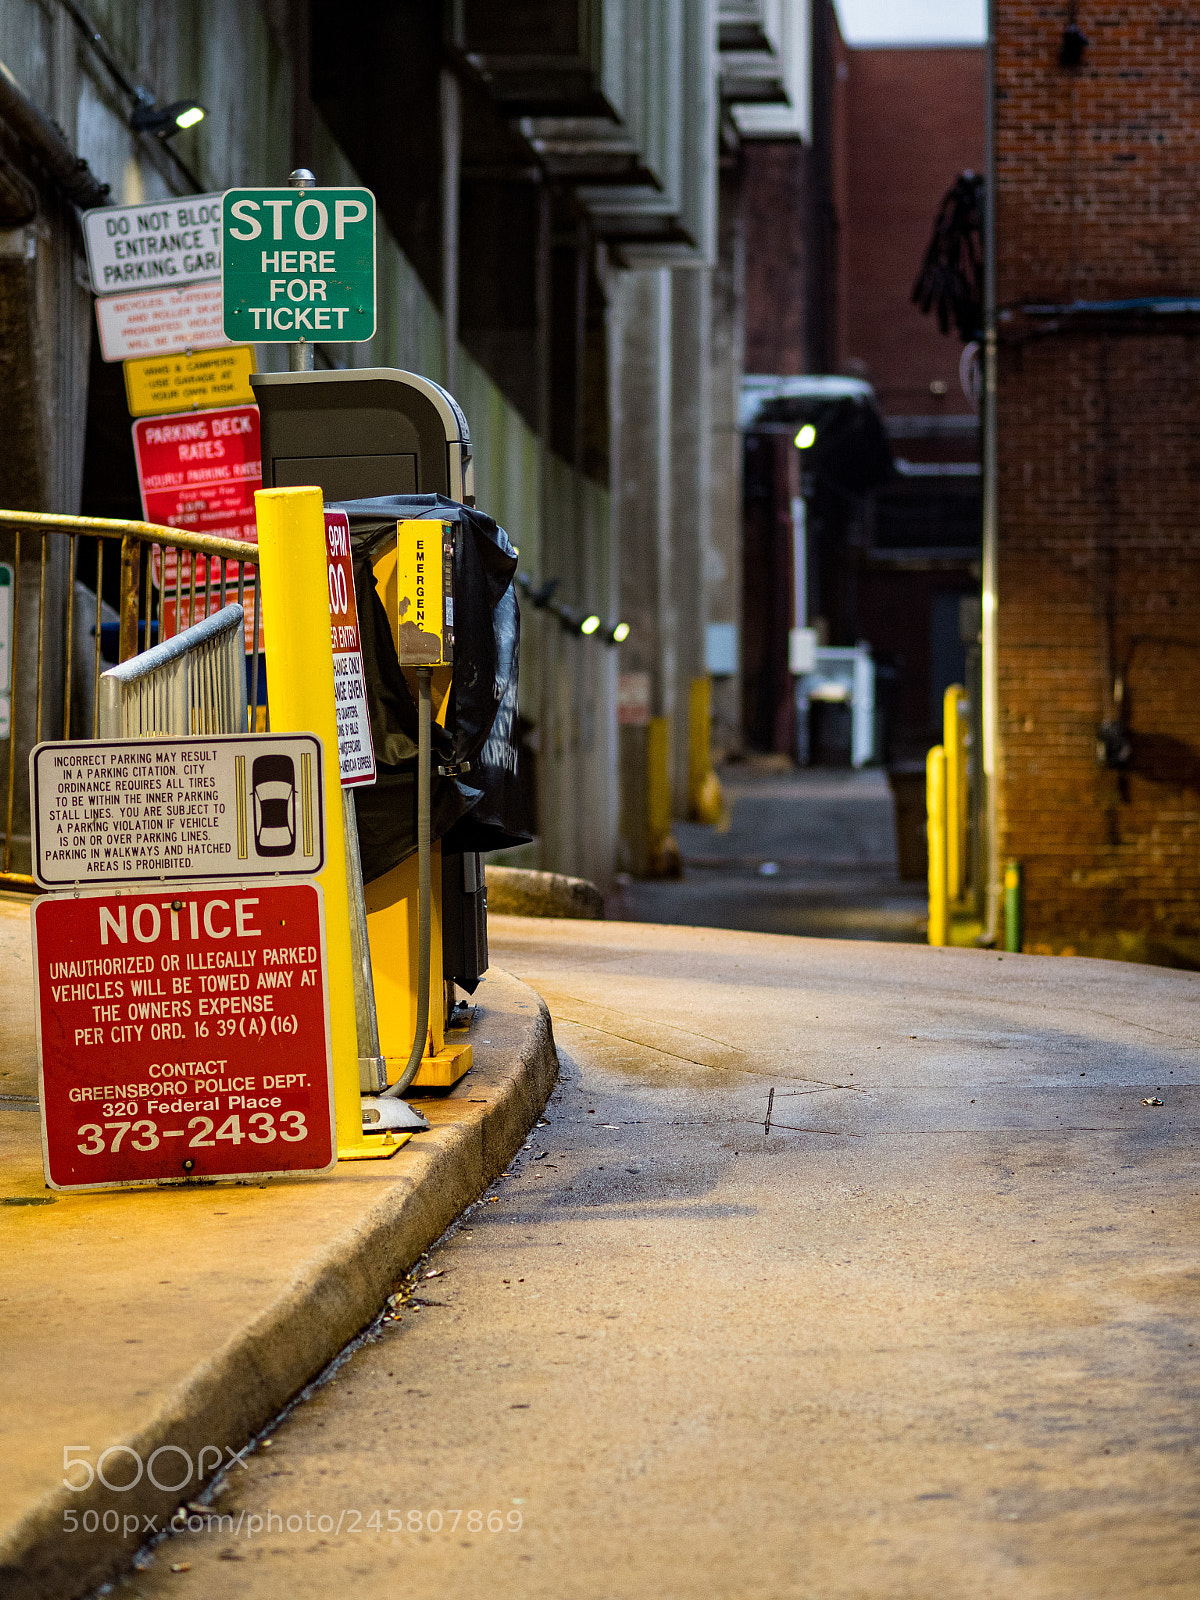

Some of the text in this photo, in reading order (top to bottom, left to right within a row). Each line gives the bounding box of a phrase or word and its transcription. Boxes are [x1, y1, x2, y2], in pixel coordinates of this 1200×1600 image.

[106, 204, 220, 237] DO NOT BLOC
[229, 199, 367, 240] STOP
[115, 228, 220, 259] ENTRANCE T
[261, 251, 336, 272] HERE
[270, 279, 327, 301] FOR
[248, 308, 349, 330] TICKET
[146, 416, 252, 445] PARKING DECK
[178, 440, 225, 462] RATES
[328, 525, 347, 556] 9PM
[416, 540, 424, 632] EMERGENC
[338, 625, 357, 648] ENTRY
[348, 679, 363, 700] GIVEN
[54, 751, 217, 767] INCORRECT PARKING MAY RESULT
[63, 764, 205, 779] IN A PARKING CITATION. CITY
[58, 777, 216, 793] ORDINANCE REQUIRES ALL TIRES
[56, 791, 219, 807] TO BE WITHIN THE INNER PARKING
[49, 804, 226, 820] STALL LINES. YOU ARE SUBJECT TO
[56, 817, 219, 834] A PARKING VIOLATION IF VEHICLE
[60, 831, 211, 846] IS ON OR OVER PARKING LINES.
[45, 843, 231, 860] PARKING IN WALKWAYS AND HATCHED
[87, 858, 193, 872] AREAS IS PROHIBITED.
[99, 898, 262, 945] NOTICE
[49, 946, 317, 980] UNAUTHORIZED OR ILLEGALLY PARKED
[52, 969, 318, 1002] VEHICLES WILL BE TOWED AWAY AT
[92, 995, 274, 1022] THE OWNERS EXPENSE
[74, 1027, 104, 1046] PER
[110, 1024, 144, 1043] CITY
[151, 1022, 186, 1041] ORD.
[195, 1021, 209, 1037] 16
[149, 1060, 228, 1078] CONTACT
[68, 1073, 311, 1102] GREENSBORO POLICE DEPT.
[102, 1095, 282, 1117] 320 Federal Place
[77, 1110, 308, 1156] 373-2433
